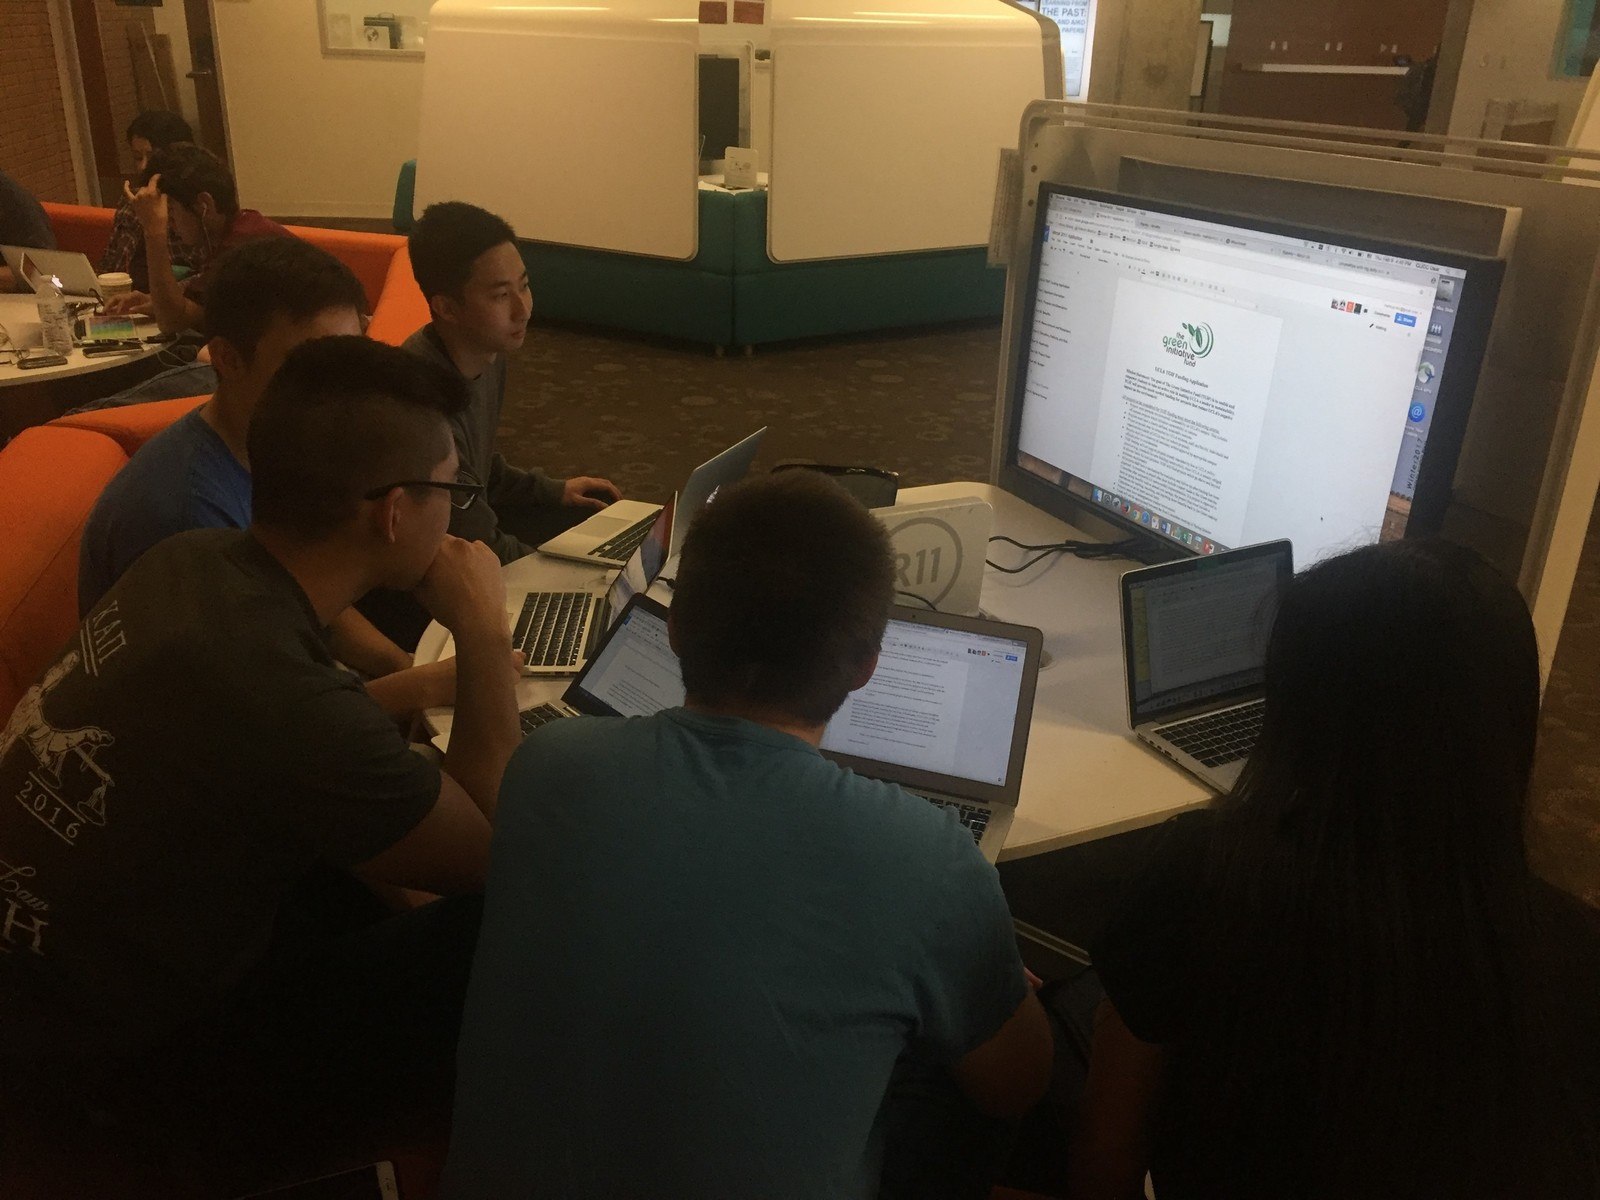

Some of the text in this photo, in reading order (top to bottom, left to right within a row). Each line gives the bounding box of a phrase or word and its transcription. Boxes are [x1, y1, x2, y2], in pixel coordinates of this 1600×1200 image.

[1042, 7, 1059, 16] THE
[1162, 335, 1188, 351] green
[1176, 332, 1185, 340] the
[1165, 346, 1195, 361] initiative
[1183, 358, 1196, 368] fund
[895, 547, 942, 587] R11
[19, 780, 81, 839] 2016
